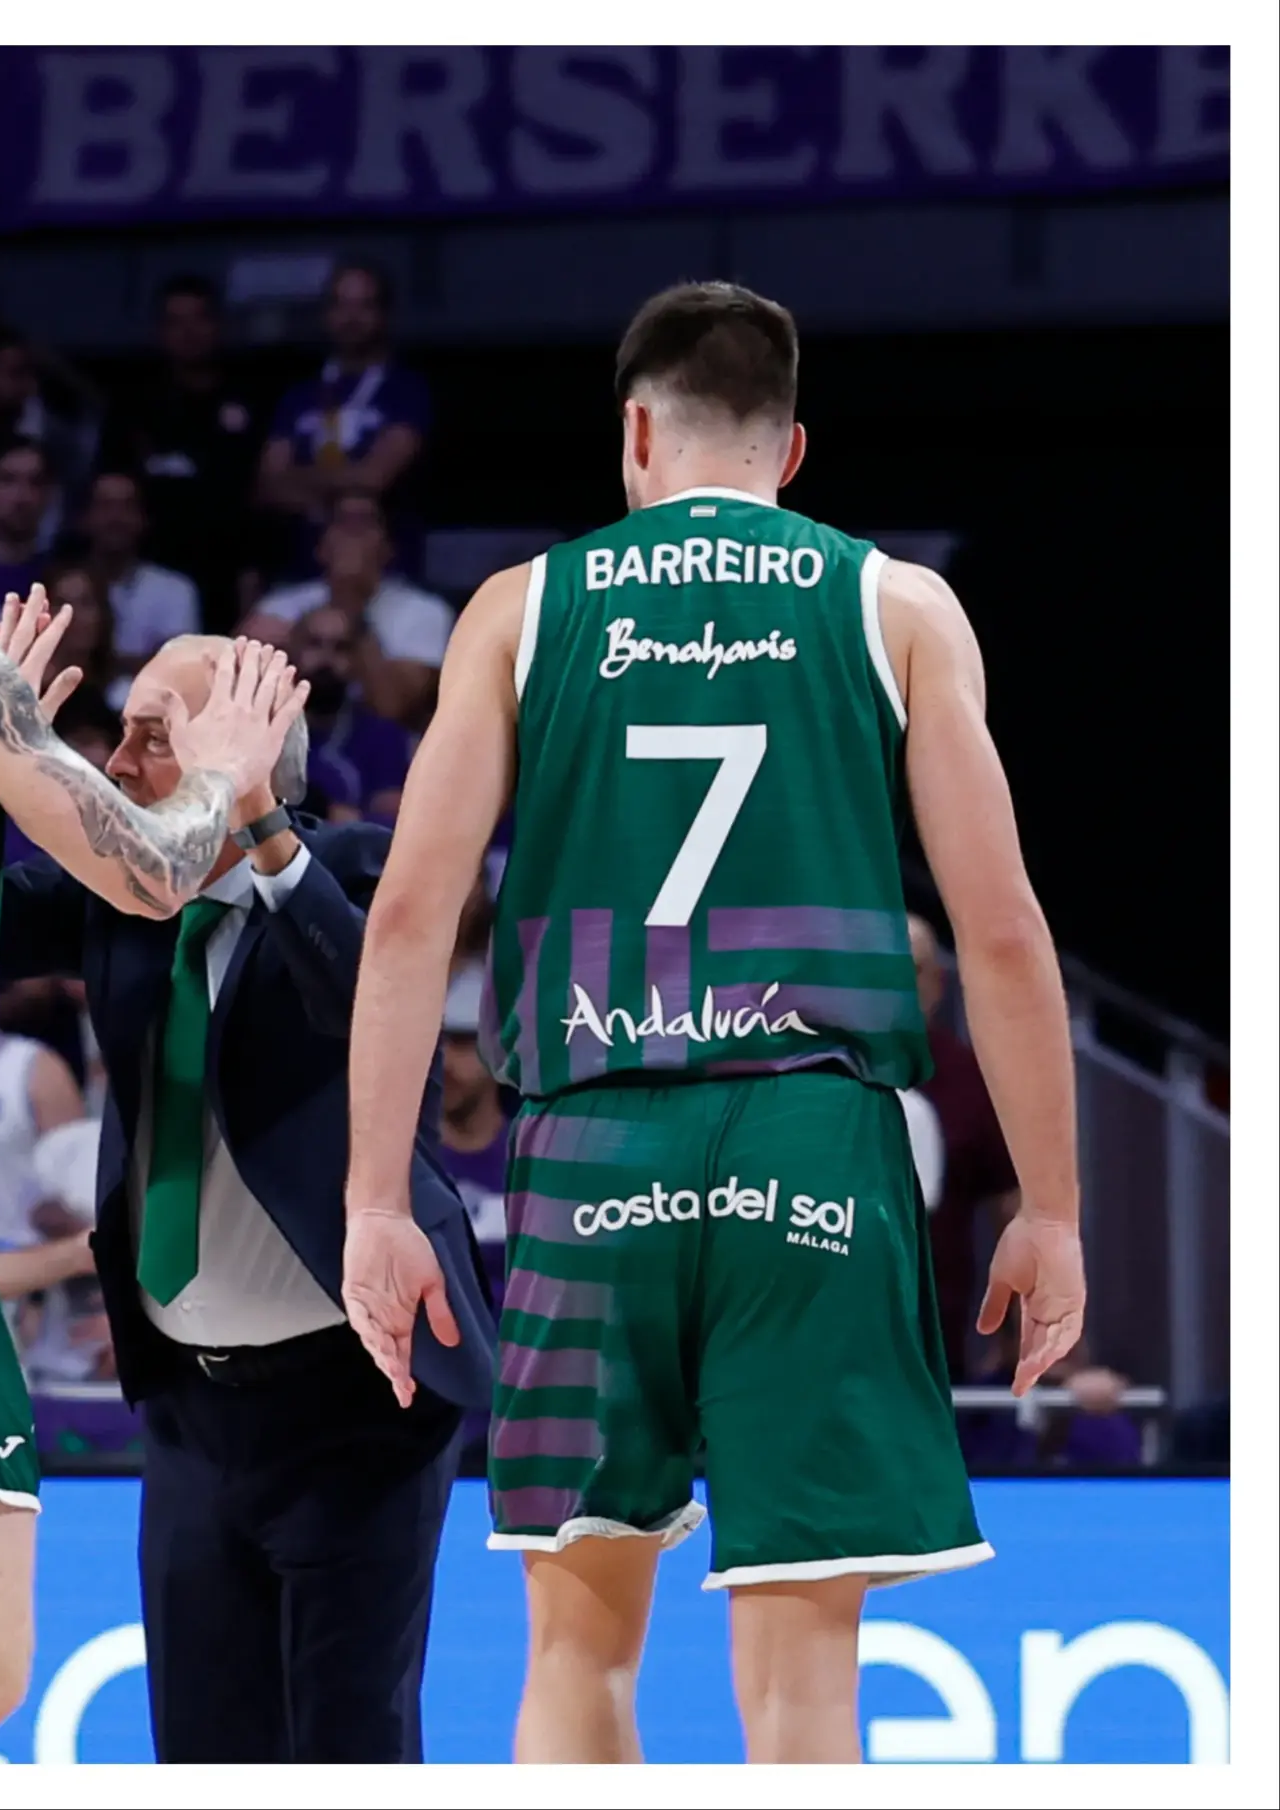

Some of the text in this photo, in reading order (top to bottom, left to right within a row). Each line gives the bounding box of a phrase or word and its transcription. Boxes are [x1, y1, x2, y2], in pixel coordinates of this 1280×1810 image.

[585, 536, 825, 591] BARREIRO
[625, 723, 768, 927] 7
[559, 981, 820, 1047] Andalucía
[573, 1176, 855, 1239] costa del sol
[786, 1230, 850, 1256] MÁLAGA
